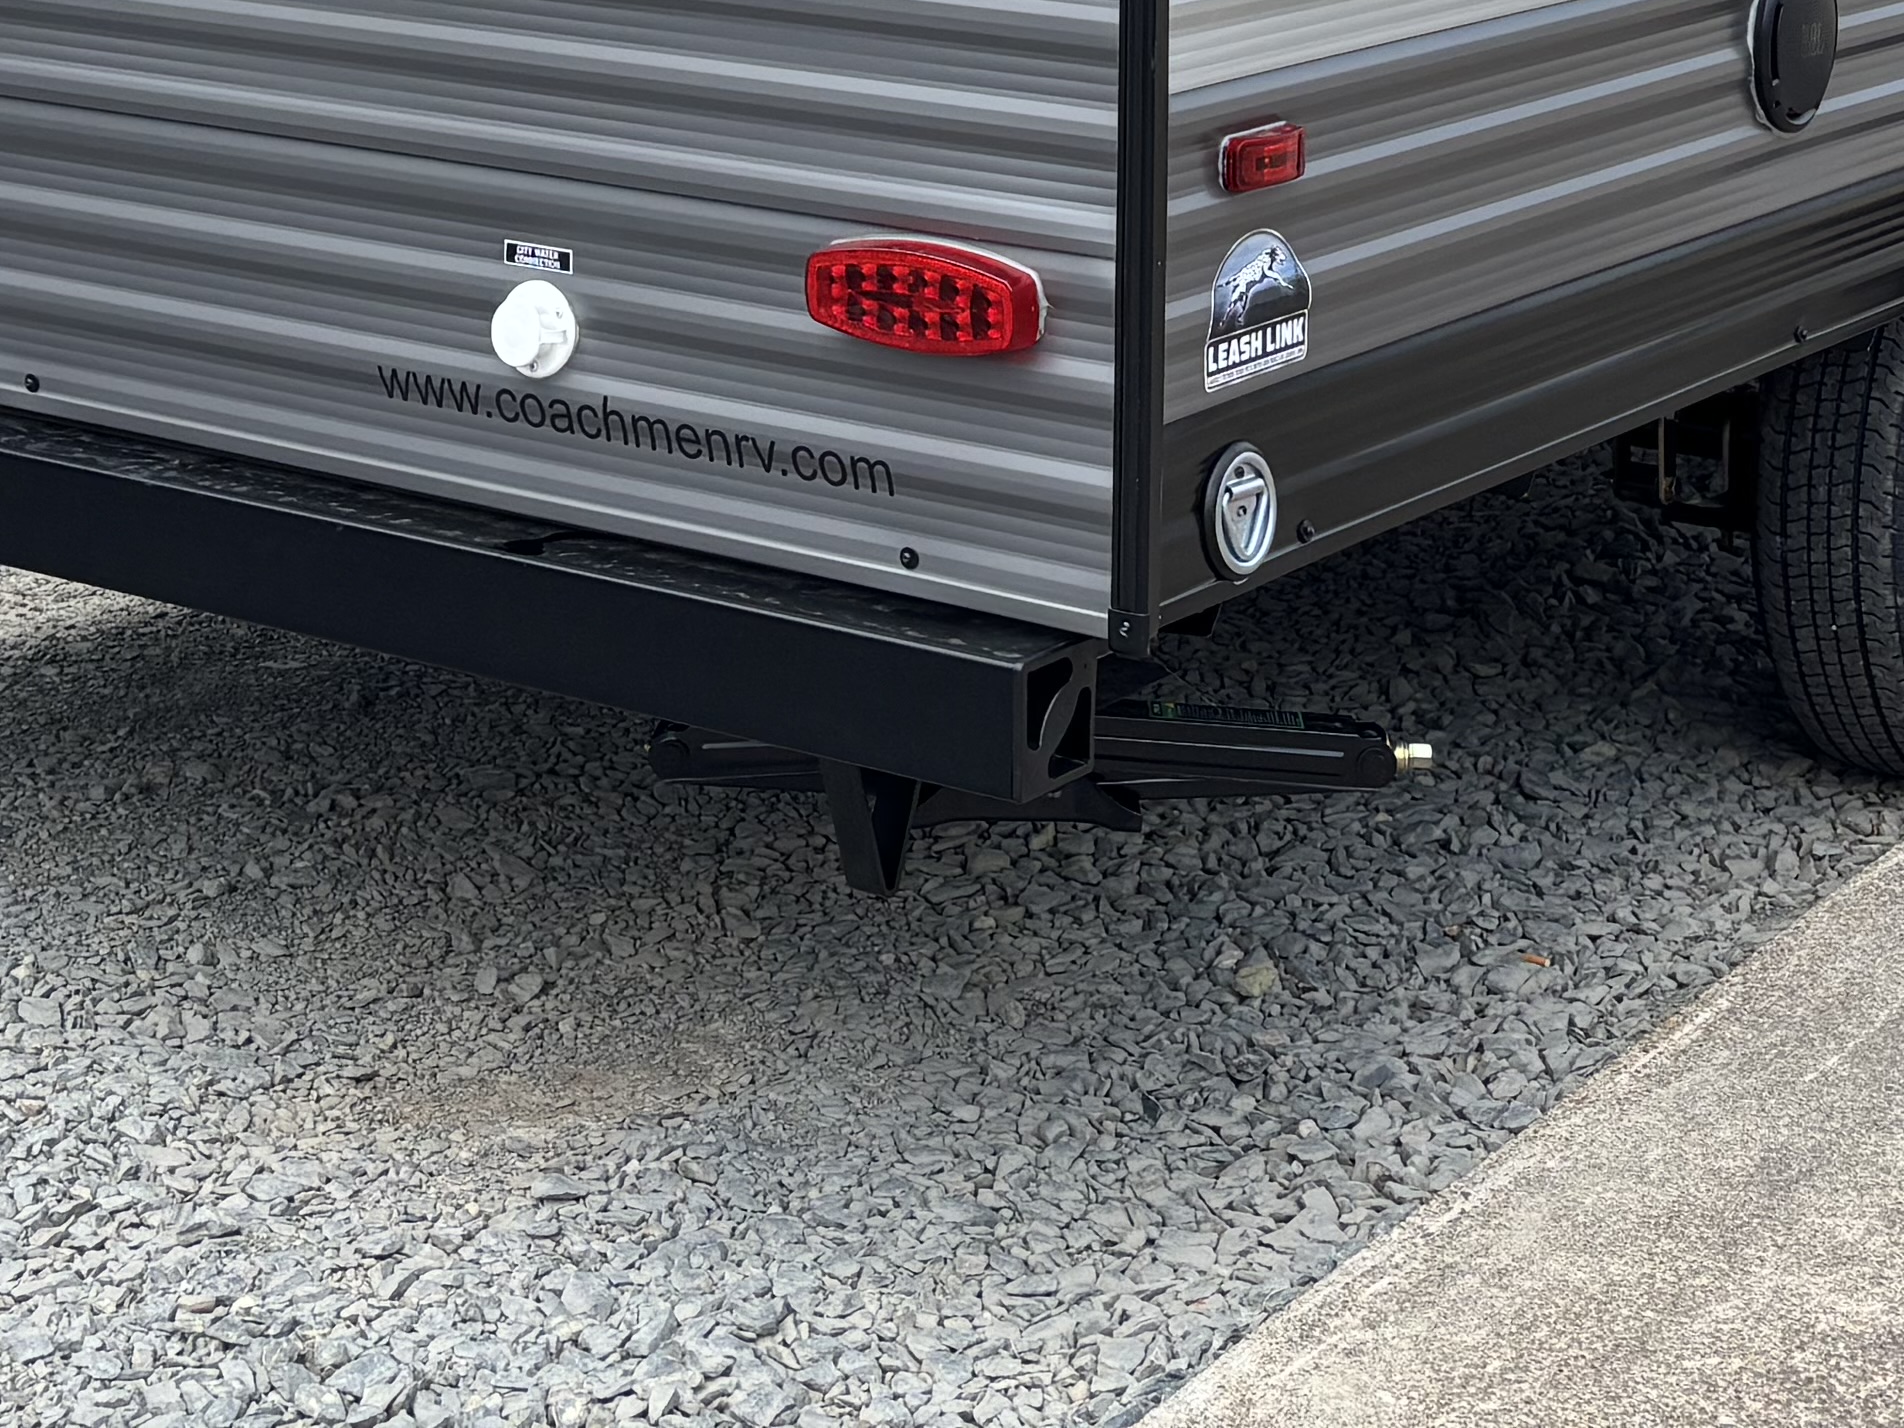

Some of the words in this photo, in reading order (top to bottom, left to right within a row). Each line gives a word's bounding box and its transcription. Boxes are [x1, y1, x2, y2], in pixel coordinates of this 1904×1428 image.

[1208, 330, 1262, 373] LEASH
[1265, 316, 1304, 352] LINK
[376, 365, 896, 497] www.coachmenrv.com
